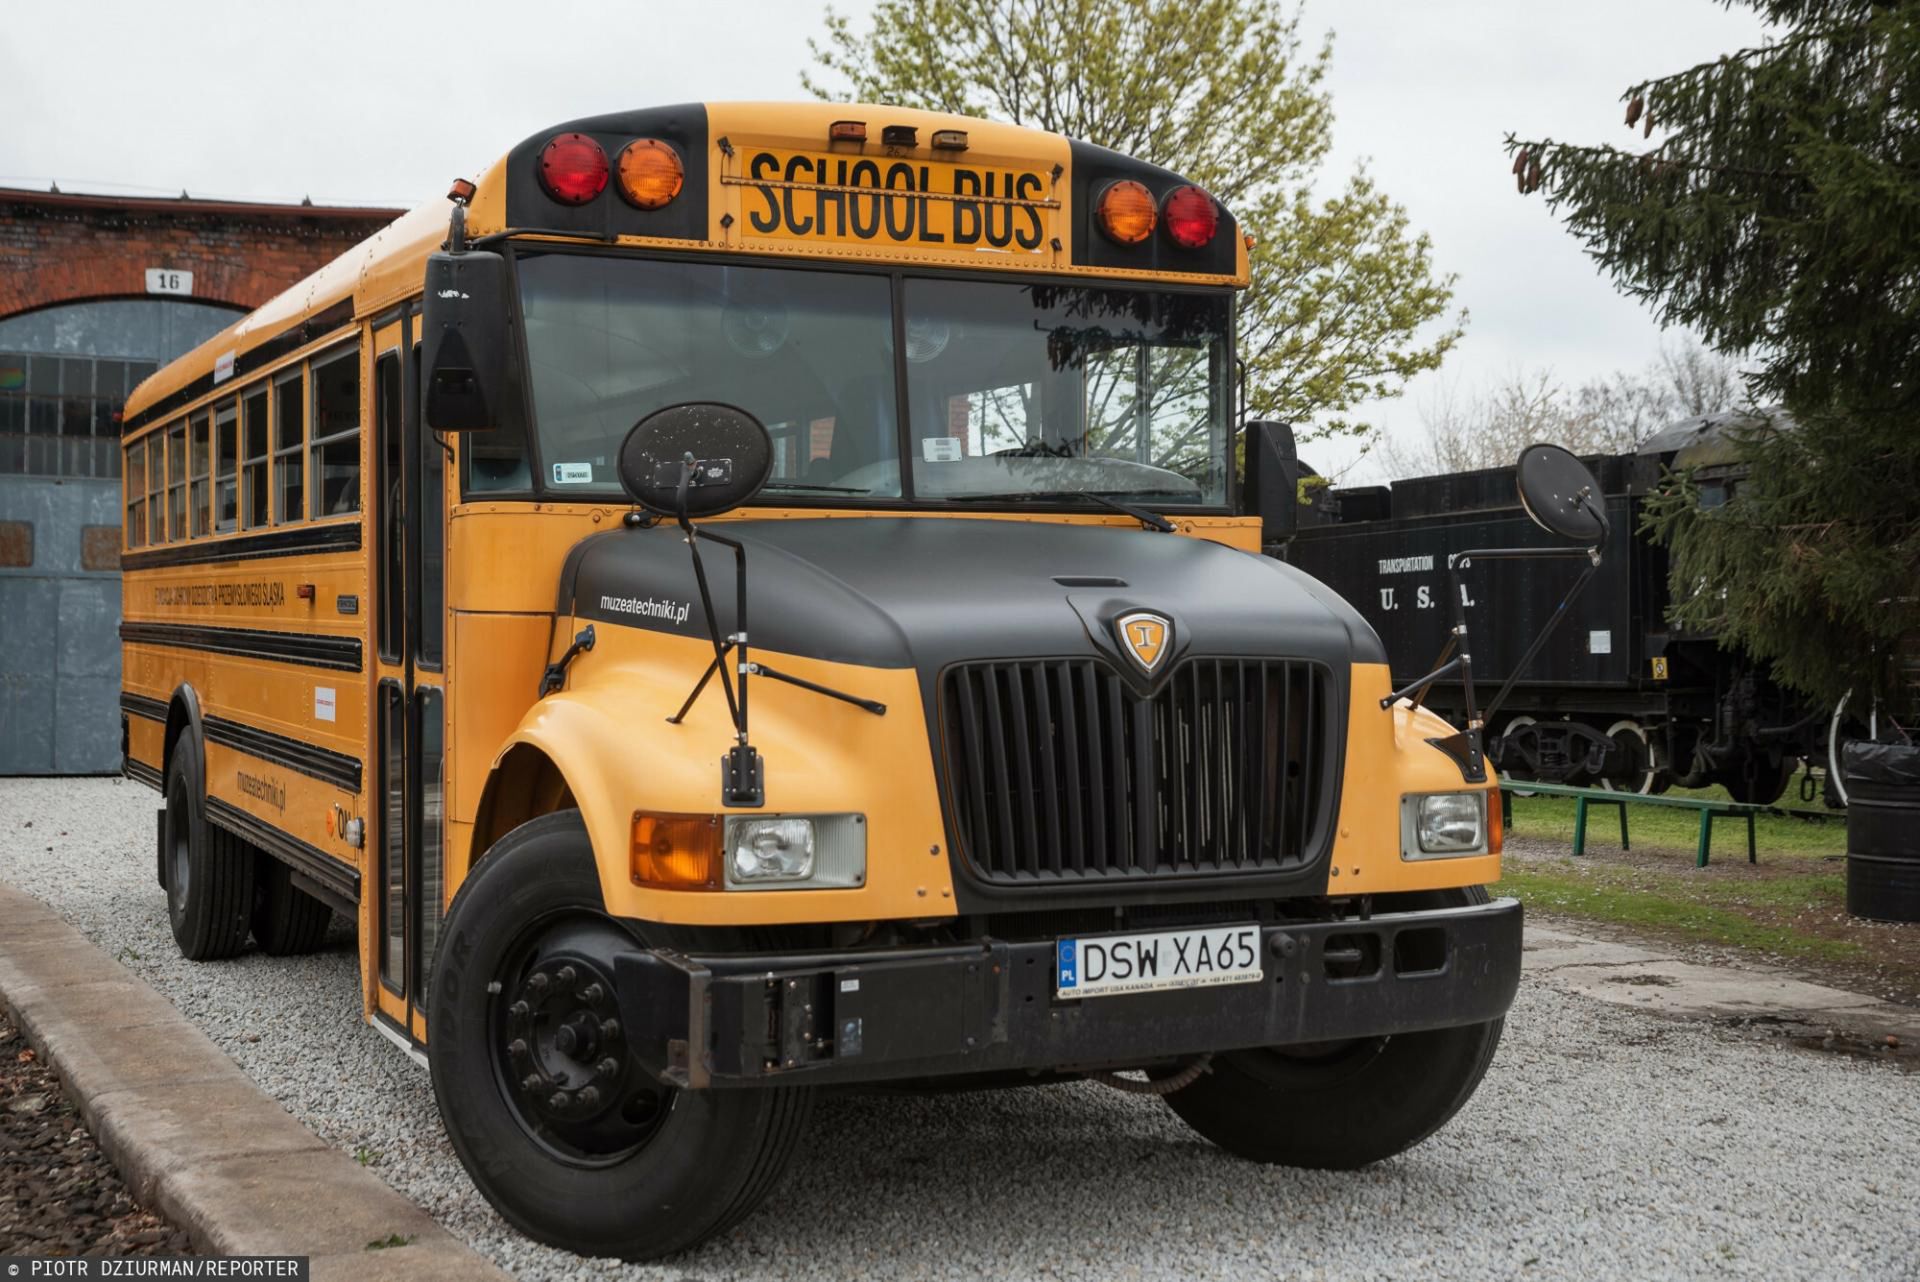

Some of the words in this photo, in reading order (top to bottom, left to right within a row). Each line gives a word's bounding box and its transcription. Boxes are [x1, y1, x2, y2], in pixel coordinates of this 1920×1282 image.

[749, 152, 945, 242] SCHOOL
[953, 169, 1044, 250] BUS
[158, 273, 180, 290] 16
[1378, 555, 1434, 575] TRANSPORTATION
[1380, 587, 1399, 610] U.
[1417, 585, 1436, 609] S.
[600, 595, 690, 625] muzeatechniki.pl
[1084, 939, 1158, 982] DSW
[1173, 932, 1255, 975] XA65
[1062, 970, 1075, 981] PL
[1083, 986, 1108, 994] IMPORT
[1125, 983, 1154, 991] KANADA
